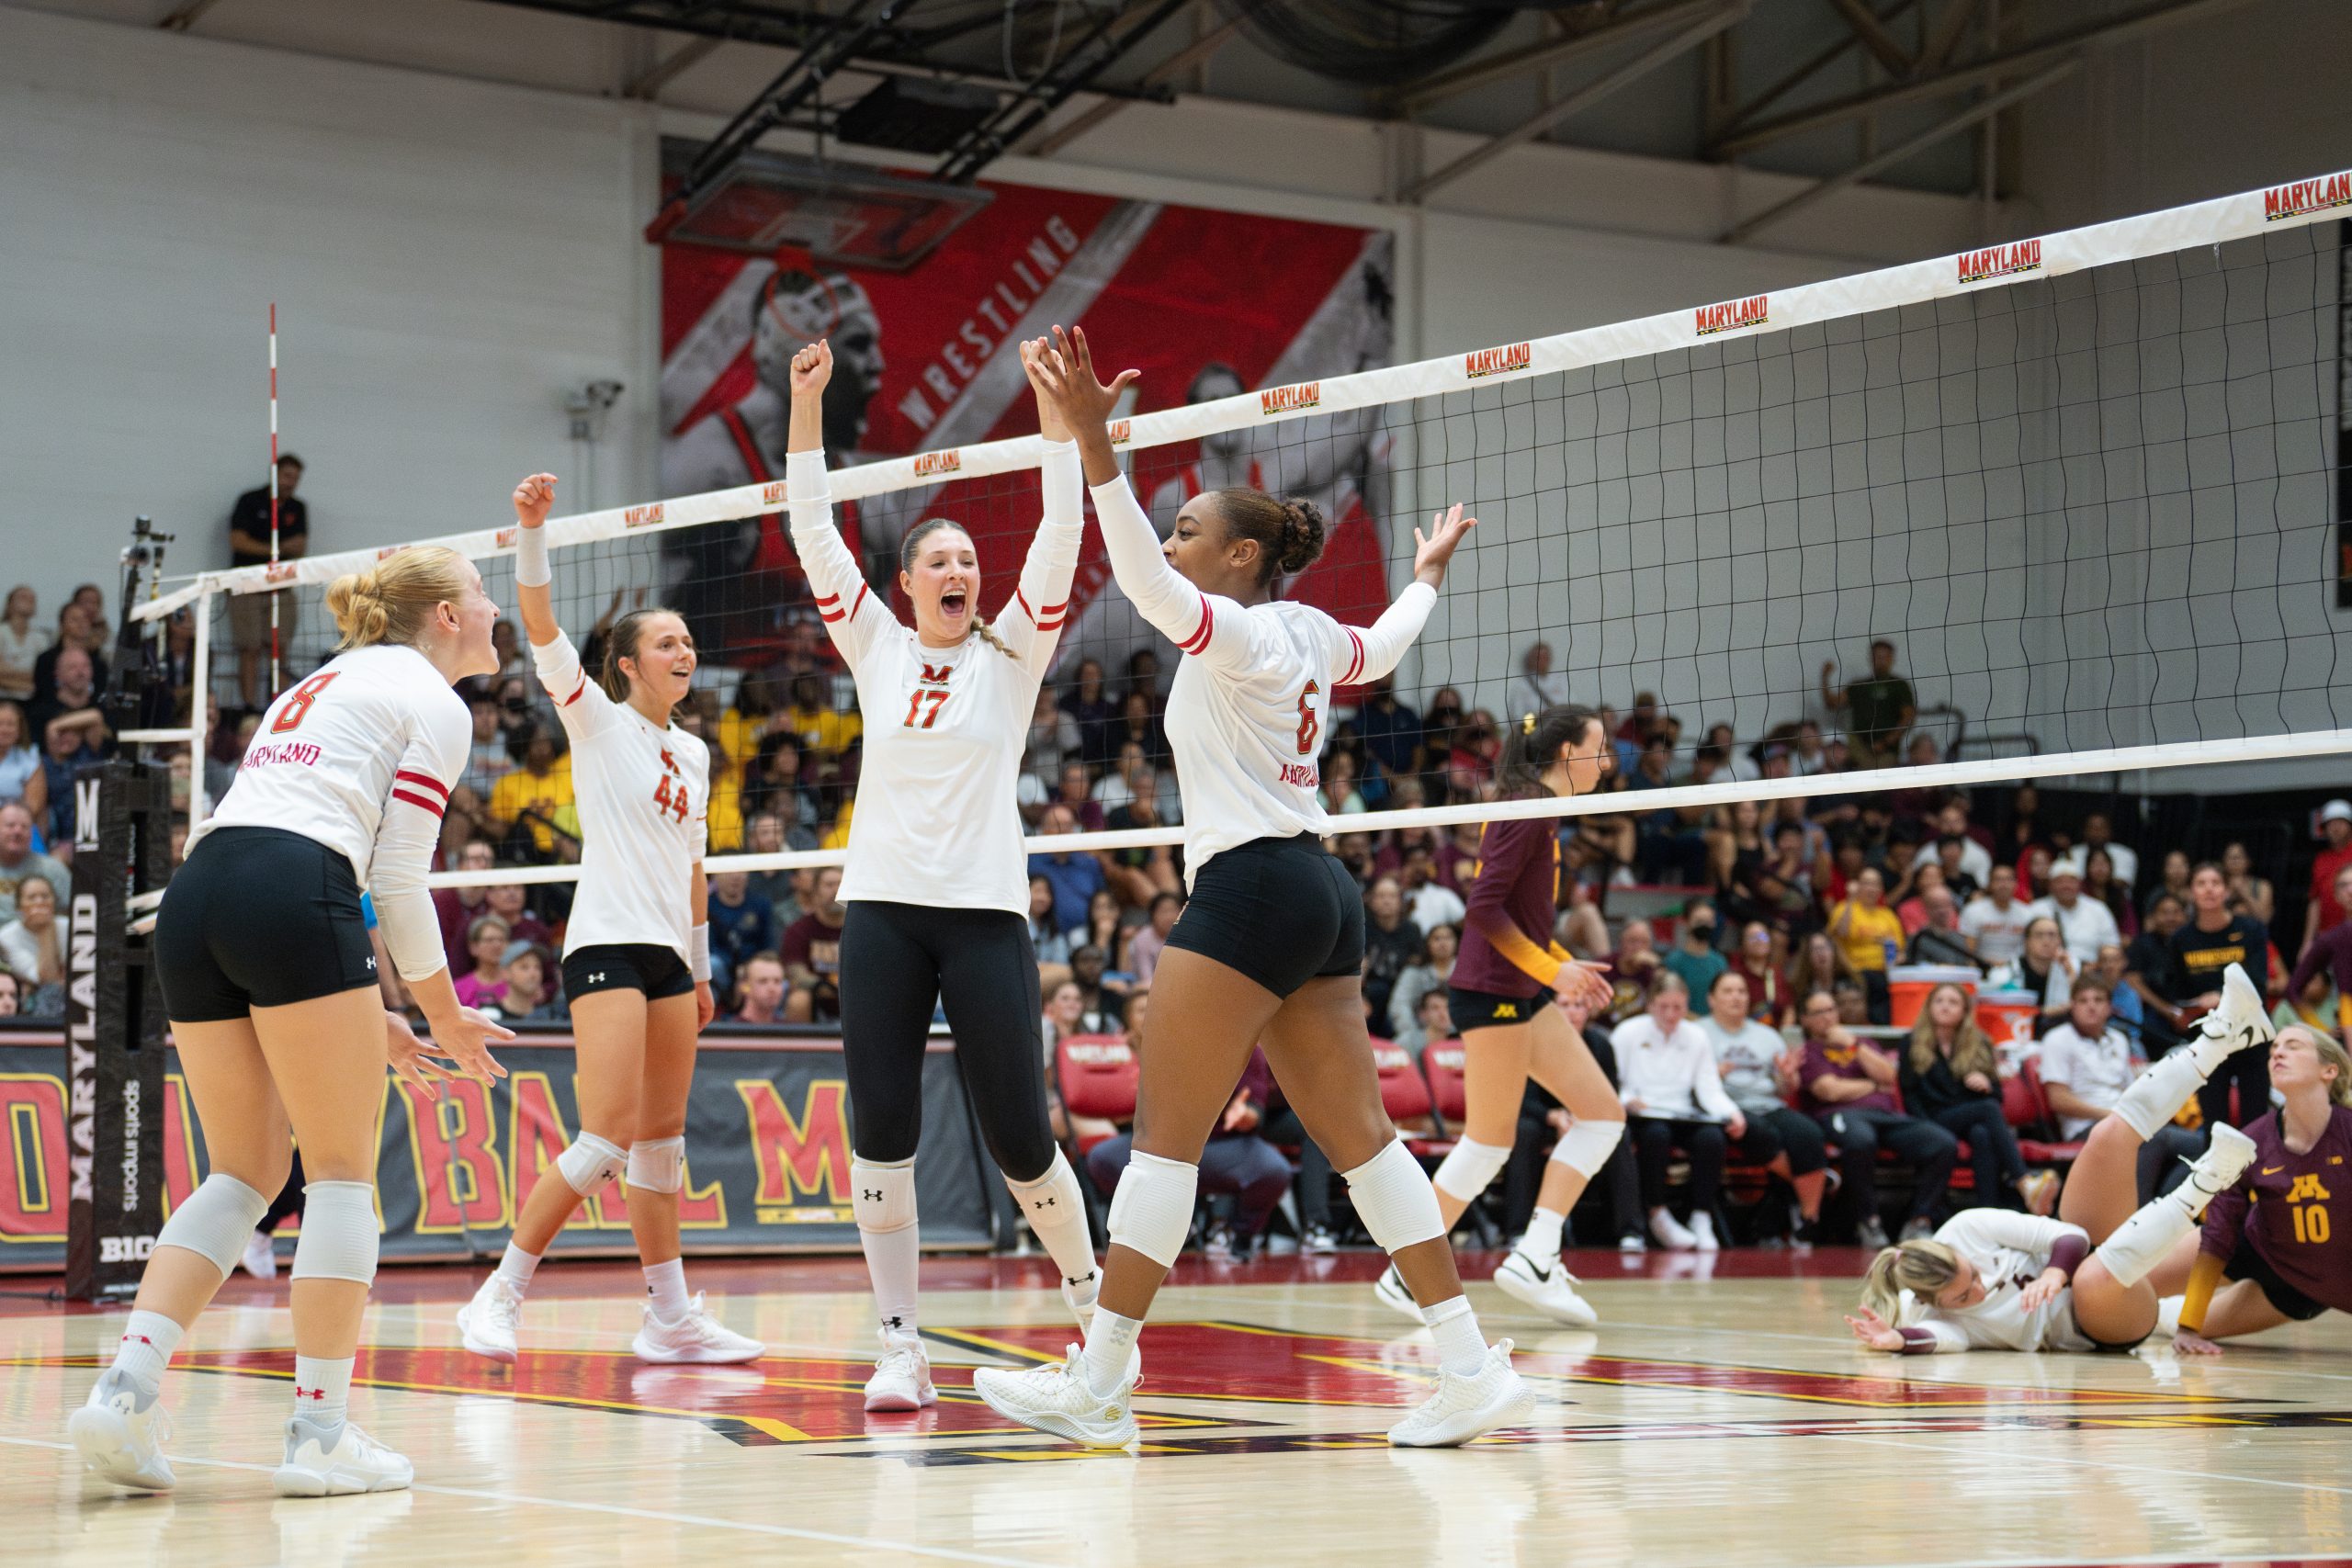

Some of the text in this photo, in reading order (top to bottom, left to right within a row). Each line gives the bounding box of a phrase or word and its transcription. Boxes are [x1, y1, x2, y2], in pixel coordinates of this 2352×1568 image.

[2264, 172, 2352, 216] MARYLAN
[1958, 239, 2041, 279] MARYLAND
[897, 215, 1079, 431] WRESTLING
[1695, 295, 1768, 332] MARYLAND
[1466, 343, 1531, 375] MARYLAND
[1261, 381, 1320, 412] MARYLAND
[270, 671, 341, 735] 8
[903, 688, 951, 729] 17
[1296, 679, 1319, 755] 6
[652, 773, 689, 825] 44
[71, 893, 97, 1204] MARYLAND
[120, 1078, 141, 1213] sports imports
[2292, 1204, 2331, 1244] 10
